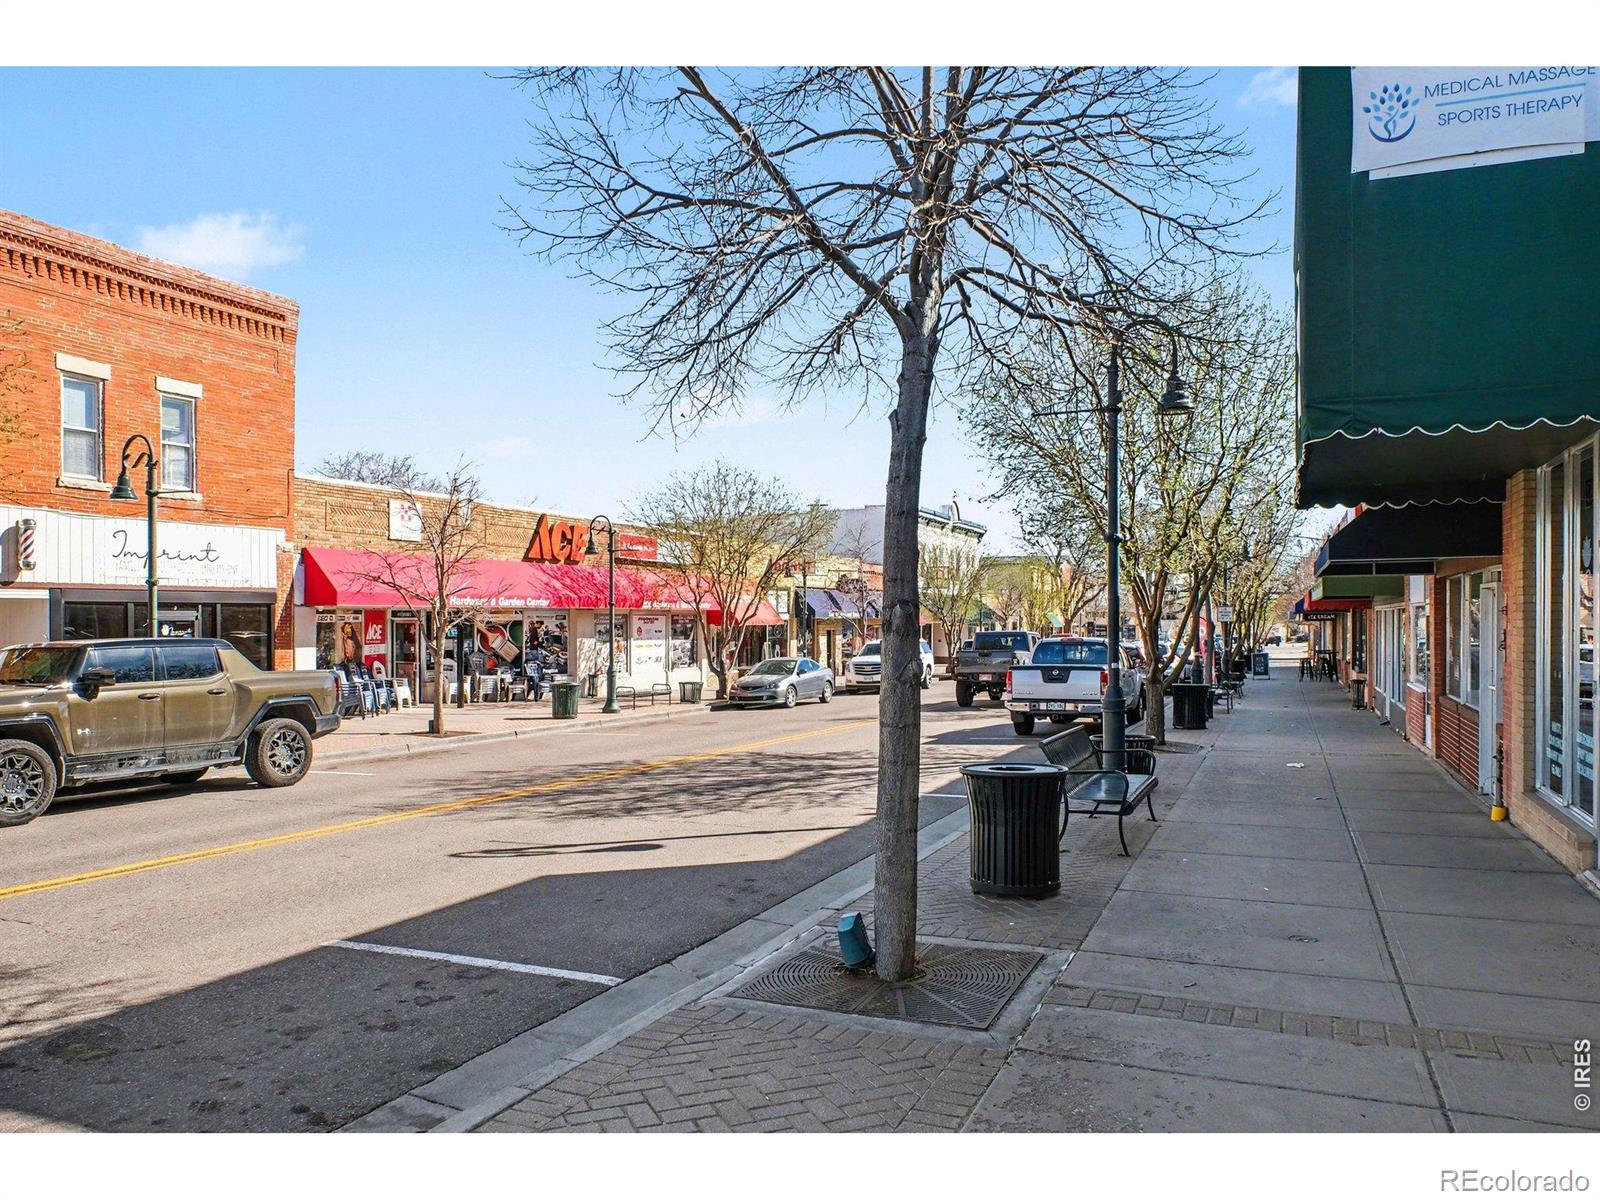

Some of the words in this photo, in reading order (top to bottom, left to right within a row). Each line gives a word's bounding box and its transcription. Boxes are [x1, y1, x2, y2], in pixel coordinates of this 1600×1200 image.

[1424, 76, 1503, 98] MEDICAL
[1508, 66, 1596, 86] MASSAGE
[1437, 105, 1501, 127] SPORTS
[1506, 94, 1583, 118] THERAPY
[523, 513, 589, 563] ACE
[499, 597, 524, 606] Garden
[526, 597, 550, 607] Center
[366, 621, 383, 640] ACE
